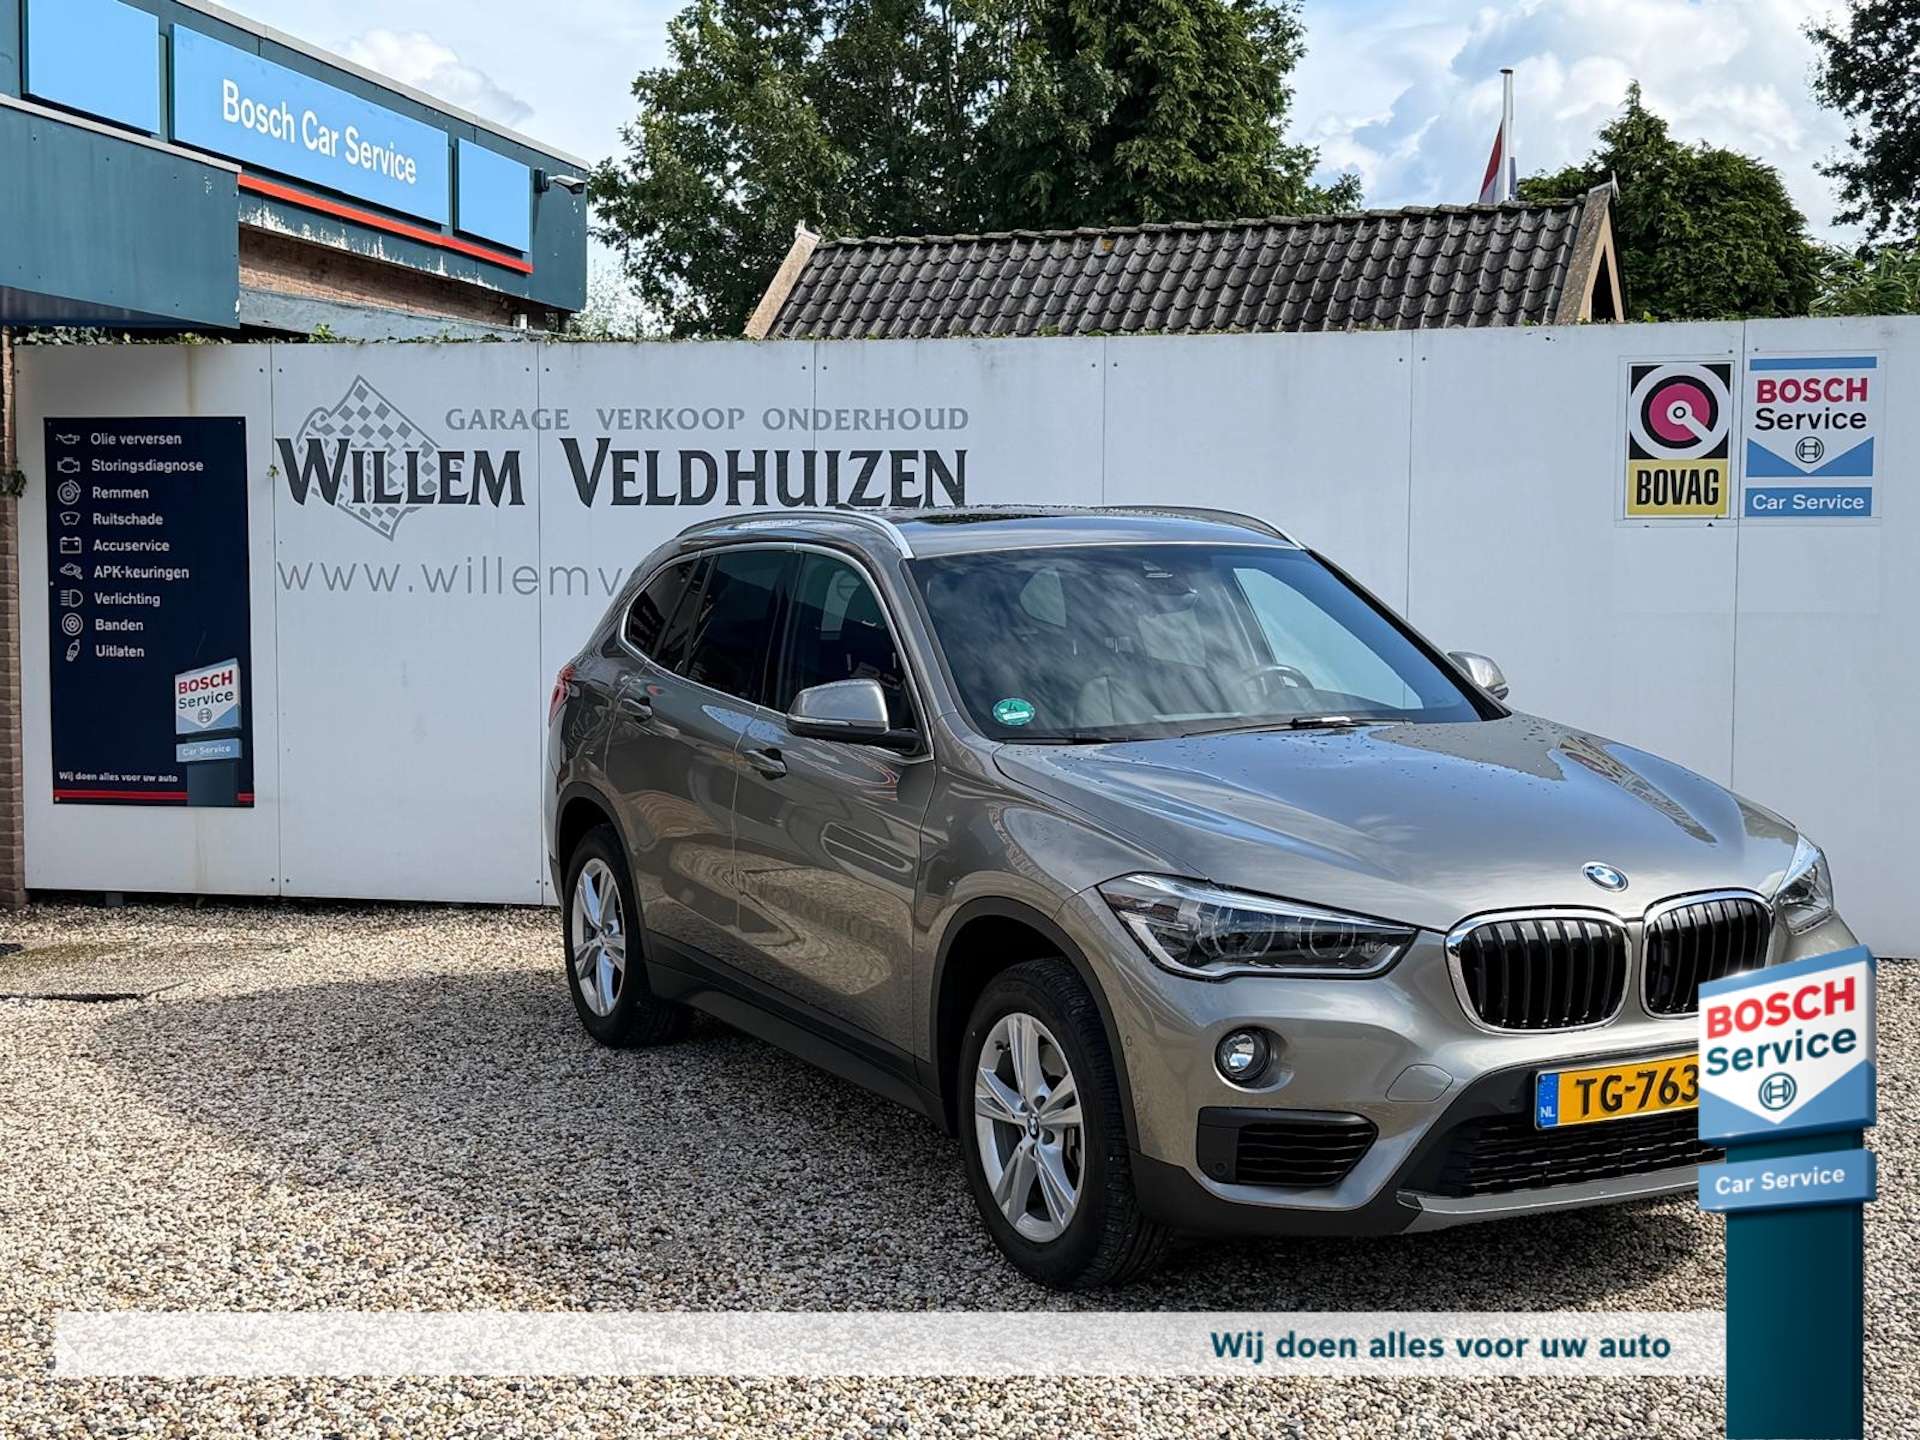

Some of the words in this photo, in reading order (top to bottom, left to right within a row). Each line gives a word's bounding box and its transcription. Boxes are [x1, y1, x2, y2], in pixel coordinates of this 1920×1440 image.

[222, 78, 296, 144] Bosch
[301, 110, 340, 158] Car
[345, 125, 417, 185] Service
[1756, 377, 1868, 404] BOSCH
[445, 408, 570, 430] GARAGE
[596, 408, 745, 430] VERKOOP
[762, 407, 969, 431] ONDERHOUD
[1755, 407, 1867, 430] Service
[90, 432, 116, 446] Olie
[119, 432, 182, 446] verversen
[91, 458, 204, 473] Storingsdiagnose
[275, 438, 526, 507] WILLEM
[560, 437, 968, 508] VELDHUIZEN
[92, 485, 149, 500] Remmen
[1636, 469, 1720, 505] BOVAG
[1752, 494, 1786, 511] Car
[1792, 493, 1866, 510] Service
[93, 512, 163, 526] Ruitschade
[93, 538, 170, 552] Accuservice
[94, 565, 190, 580] APK-keuringen
[94, 591, 161, 607] Verlichting
[95, 618, 144, 632] Banden
[95, 644, 145, 659] Uitlaten
[178, 670, 233, 695] BOSCH
[178, 689, 234, 710] Service
[59, 771, 74, 782] Wij
[76, 771, 97, 781] doen
[99, 772, 120, 782] alles
[122, 773, 141, 782] voor
[144, 774, 157, 782] uw
[159, 773, 178, 783] auto
[1540, 1106, 1556, 1119] NL
